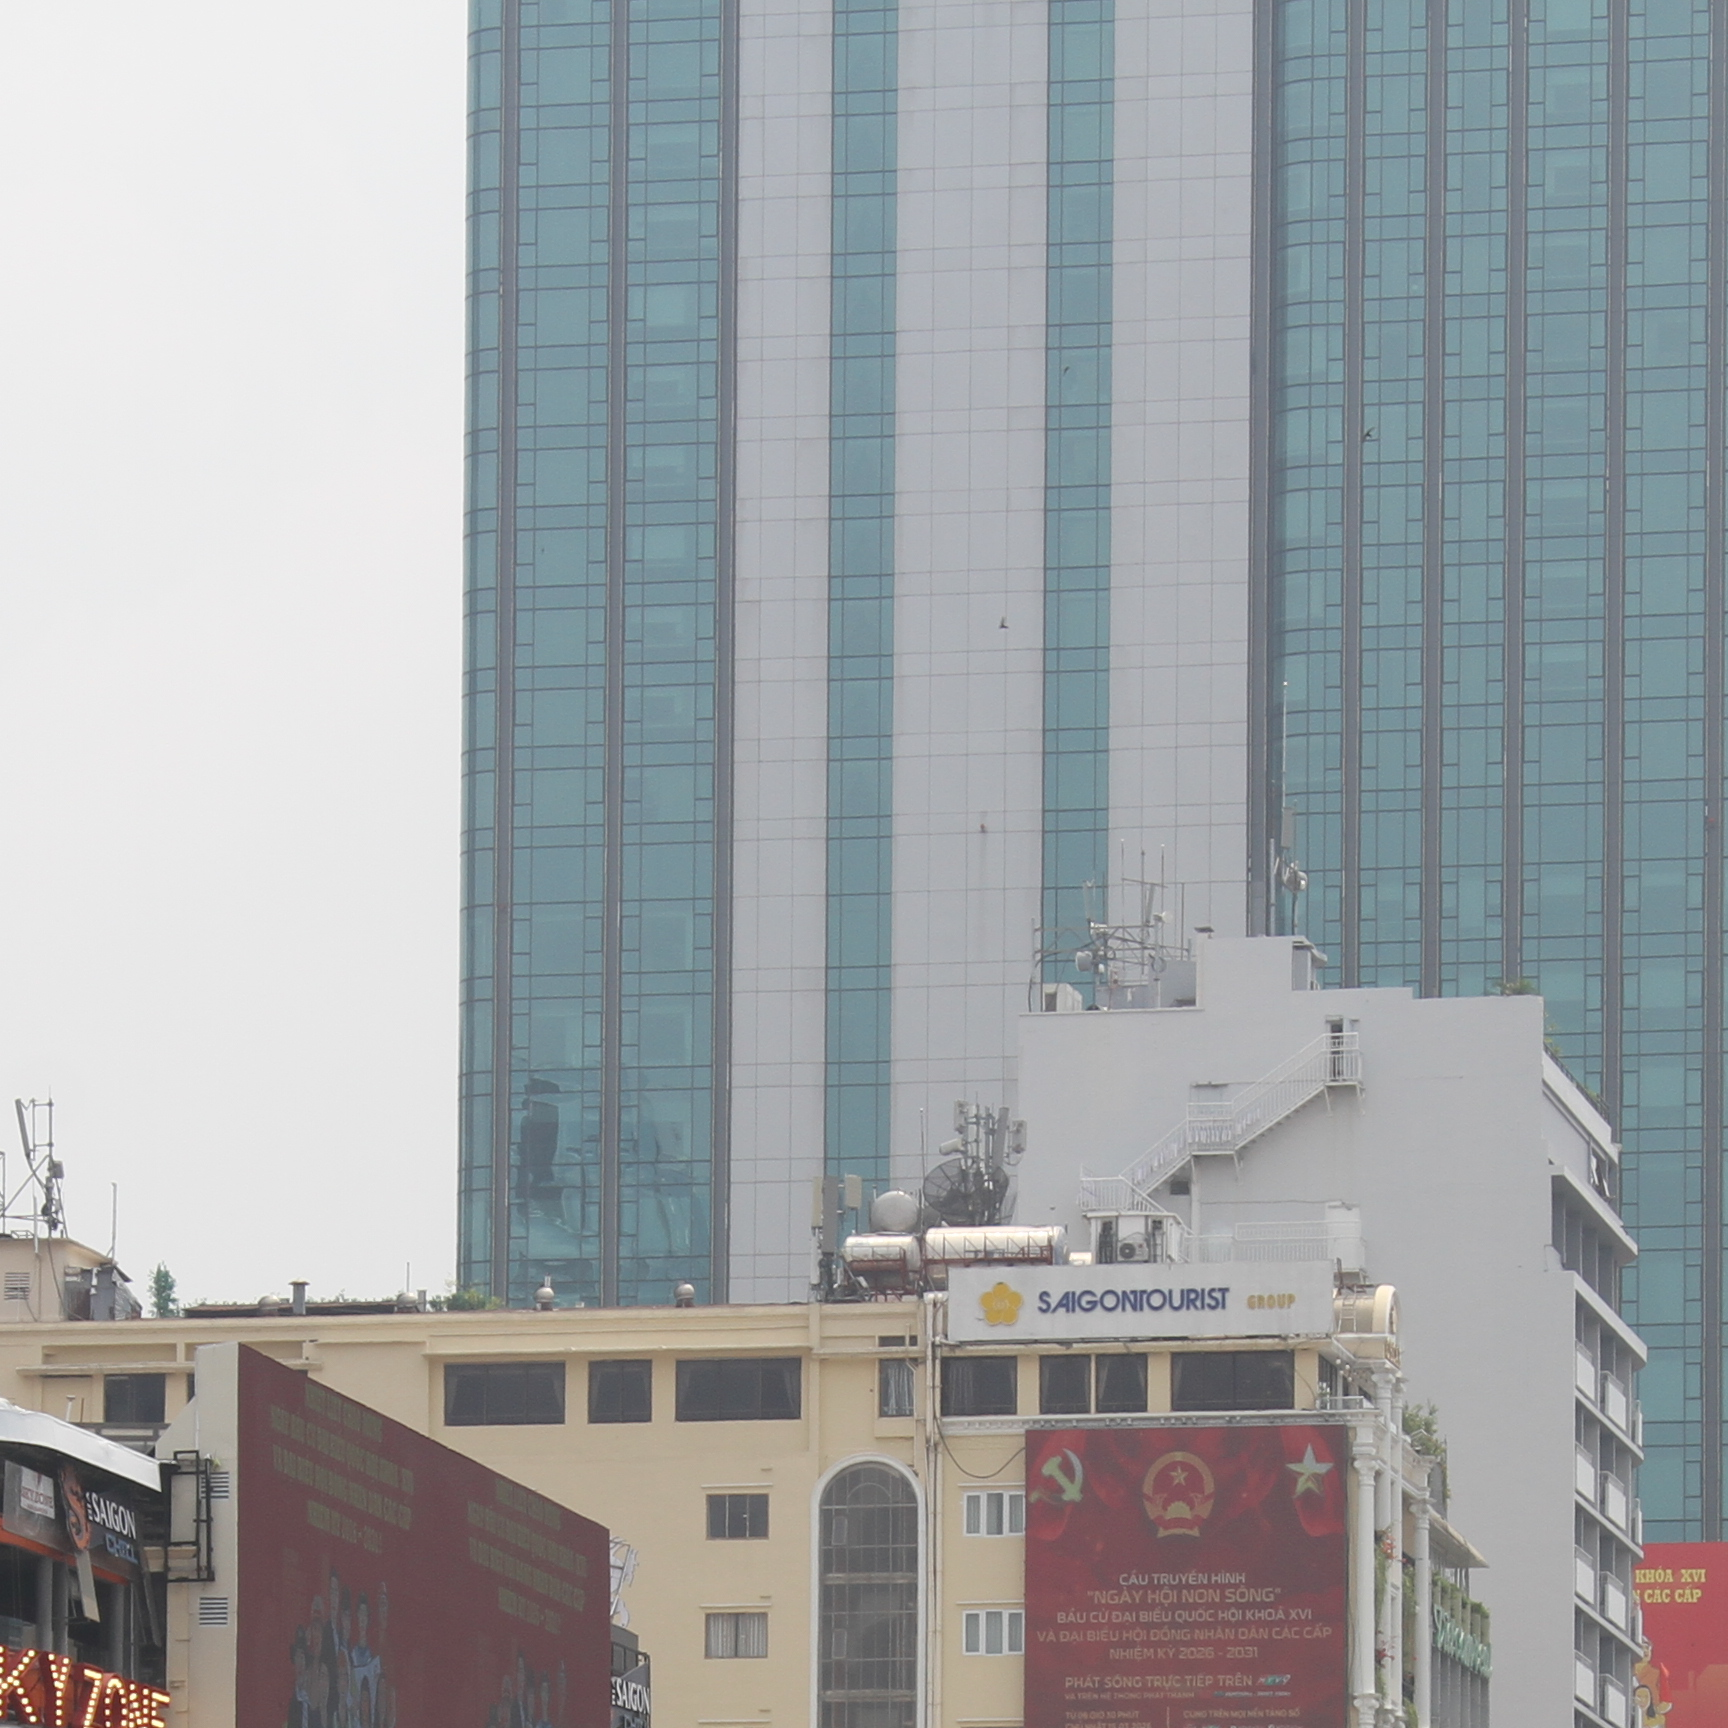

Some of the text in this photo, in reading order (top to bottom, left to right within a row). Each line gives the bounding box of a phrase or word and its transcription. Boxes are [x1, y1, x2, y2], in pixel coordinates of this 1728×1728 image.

[1038, 1287, 1230, 1314] SAIGONTOURIST
[92, 1493, 136, 1540] SAIGON
[1635, 1566, 1706, 1583] KHÓA XVI
[1180, 1589, 1221, 1603] NON
[1644, 1585, 1670, 1603] CÁC
[1289, 1608, 1312, 1620] XVI
[1179, 1646, 1214, 1659] 2026
[1227, 1646, 1258, 1659] 2031
[616, 1677, 650, 1714] SAIGON
